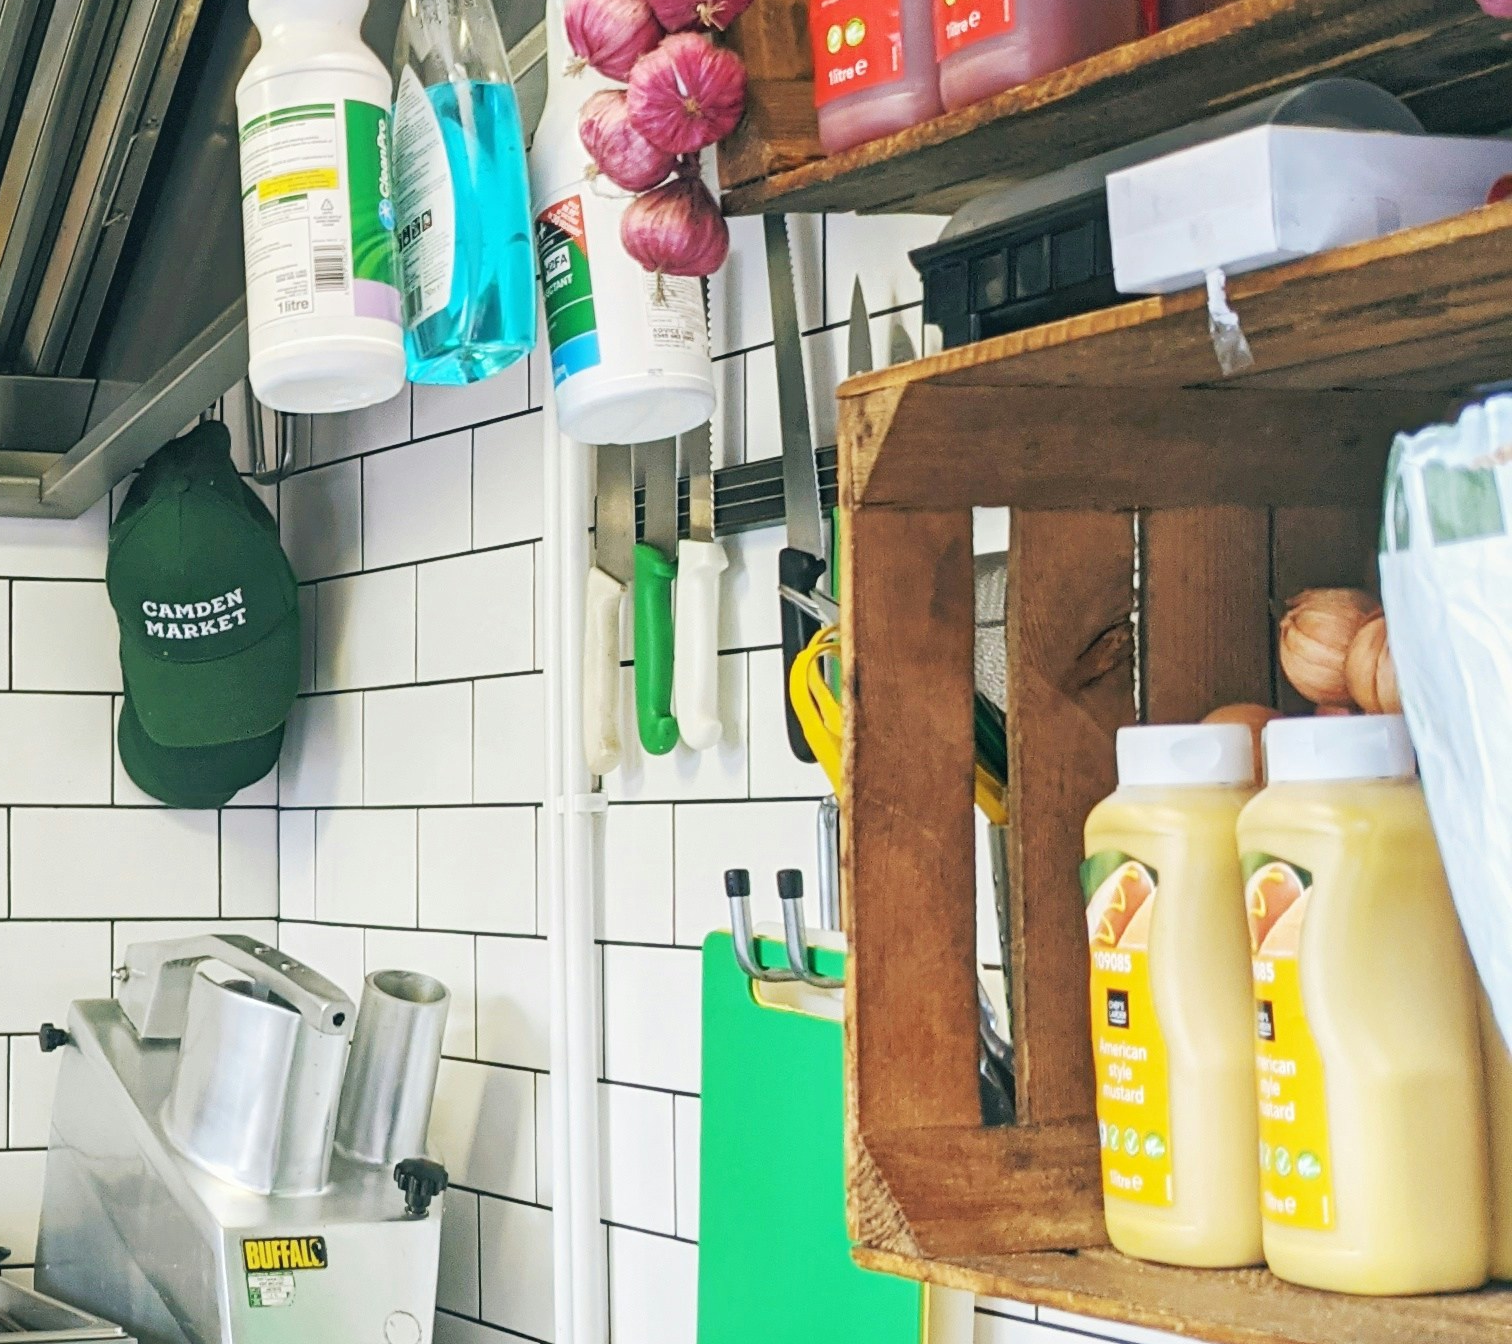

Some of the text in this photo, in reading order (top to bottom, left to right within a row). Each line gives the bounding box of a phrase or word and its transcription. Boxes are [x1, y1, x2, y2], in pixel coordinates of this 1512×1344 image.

[142, 587, 244, 619] CAMDEN
[145, 608, 246, 639] MARKET
[1108, 1062, 1132, 1085] style
